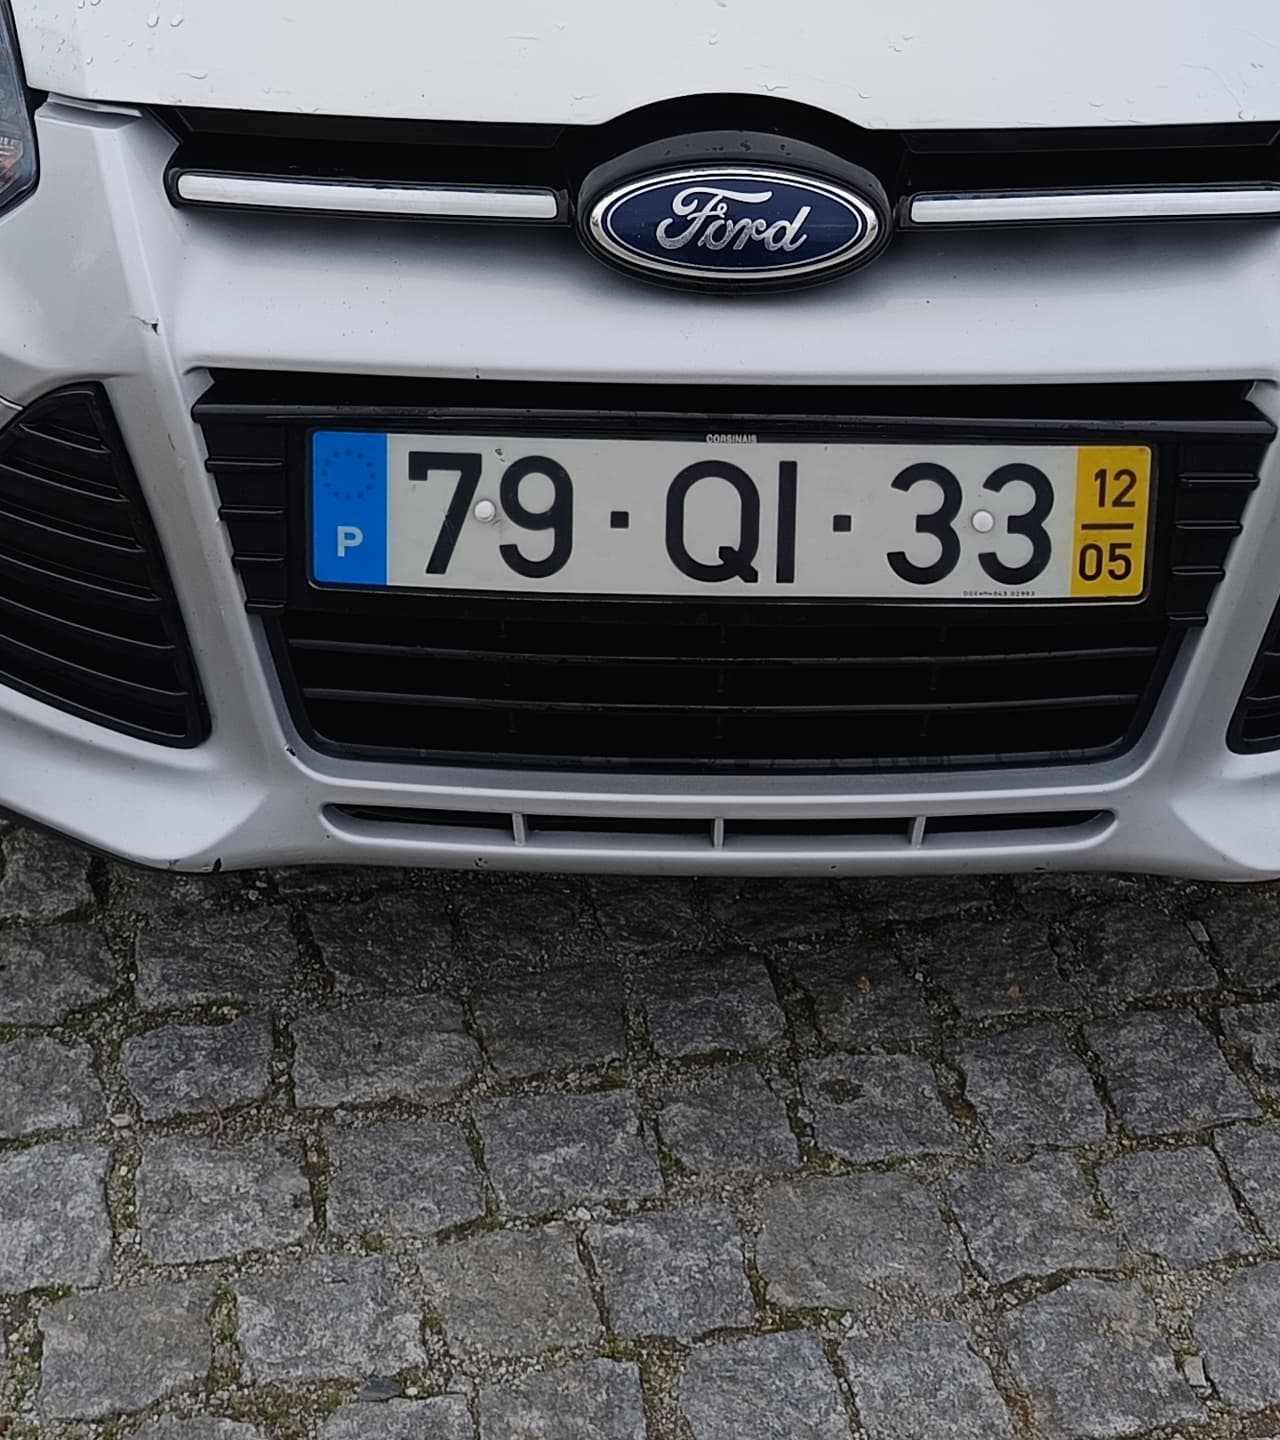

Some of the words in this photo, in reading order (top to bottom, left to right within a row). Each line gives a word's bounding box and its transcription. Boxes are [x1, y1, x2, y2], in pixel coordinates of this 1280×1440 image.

[655, 186, 811, 252] Ford
[1094, 468, 1138, 508] 12
[336, 525, 364, 558] P
[1078, 543, 1133, 582] 05
